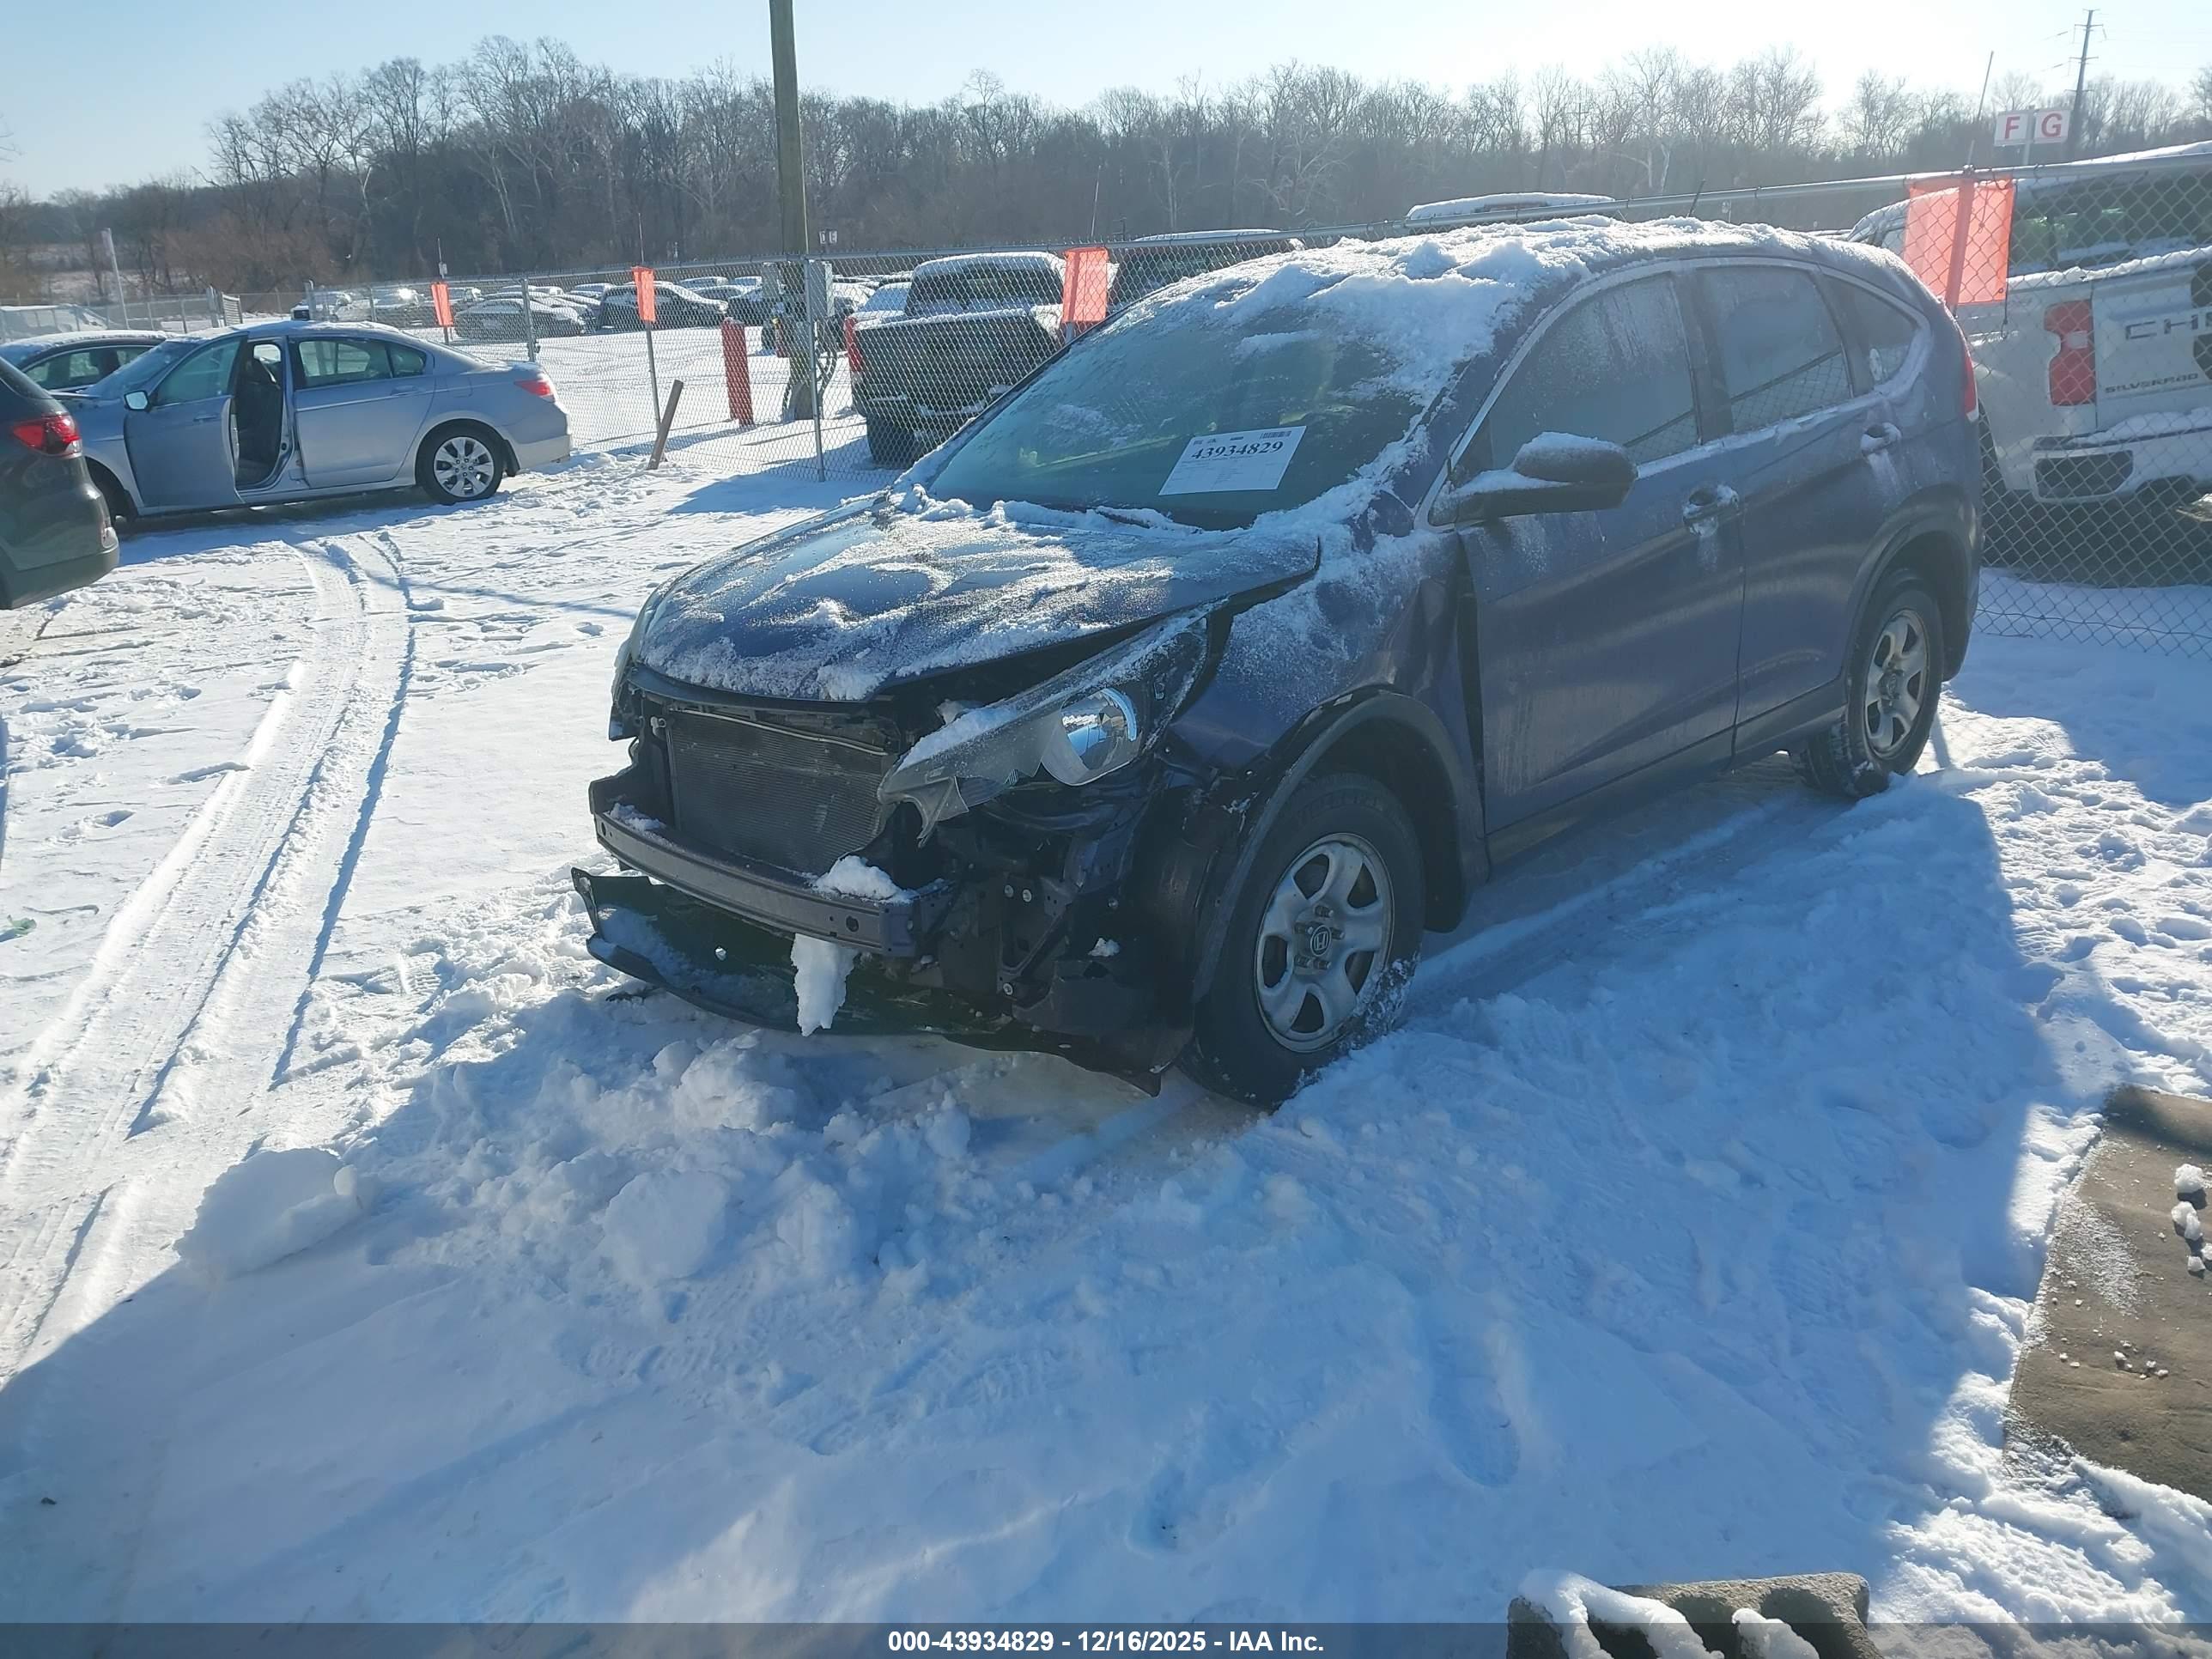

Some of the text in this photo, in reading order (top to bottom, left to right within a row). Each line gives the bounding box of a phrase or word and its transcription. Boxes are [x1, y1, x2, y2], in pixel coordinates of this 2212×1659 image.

[2004, 116, 2021, 139] F
[2041, 112, 2063, 137] G
[2125, 312, 2212, 340] CH
[1191, 441, 1284, 459] 43934829
